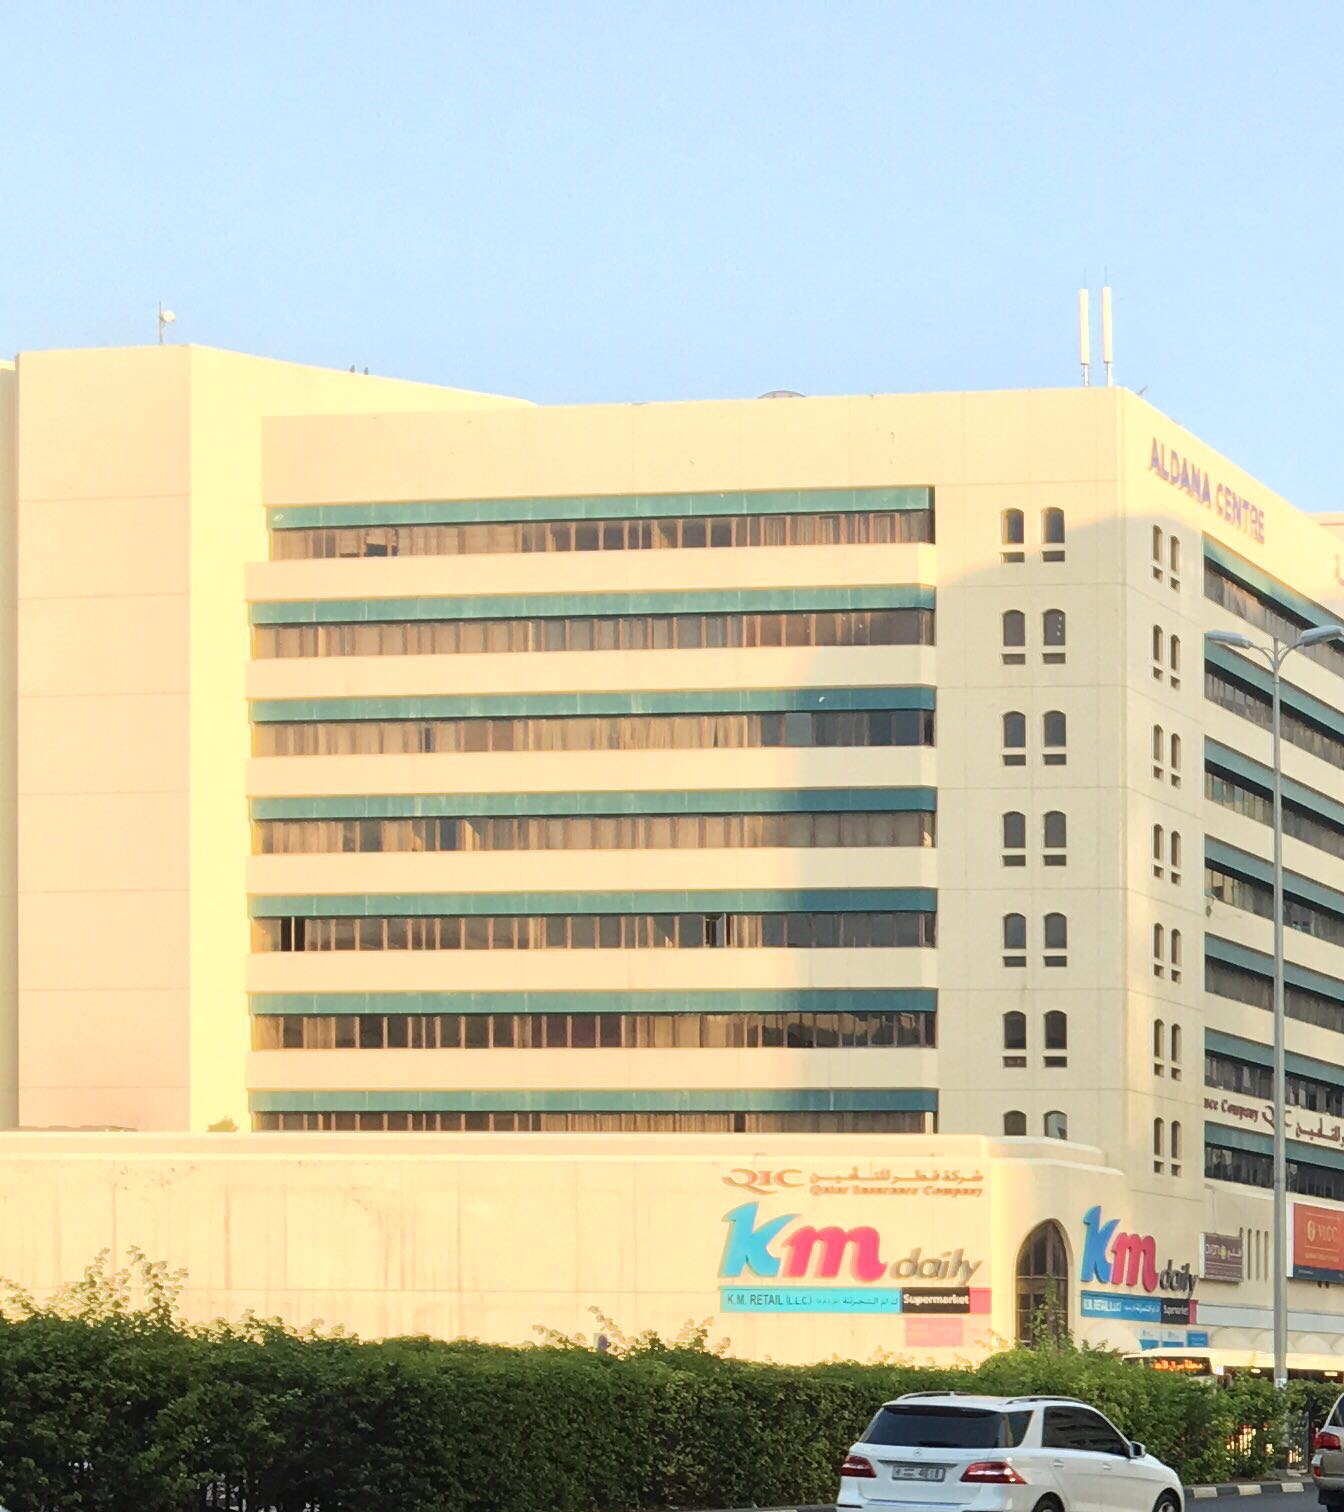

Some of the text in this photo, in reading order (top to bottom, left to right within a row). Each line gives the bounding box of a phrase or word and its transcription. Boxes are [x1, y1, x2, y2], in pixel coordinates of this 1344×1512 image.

[1148, 436, 1264, 544] ALDANA CENTRE
[722, 1168, 805, 1196] QIC
[889, 1247, 984, 1287] daily
[1159, 1258, 1200, 1300] daily
[750, 1294, 784, 1306] RETAIL
[902, 1292, 970, 1306] Supermarket
